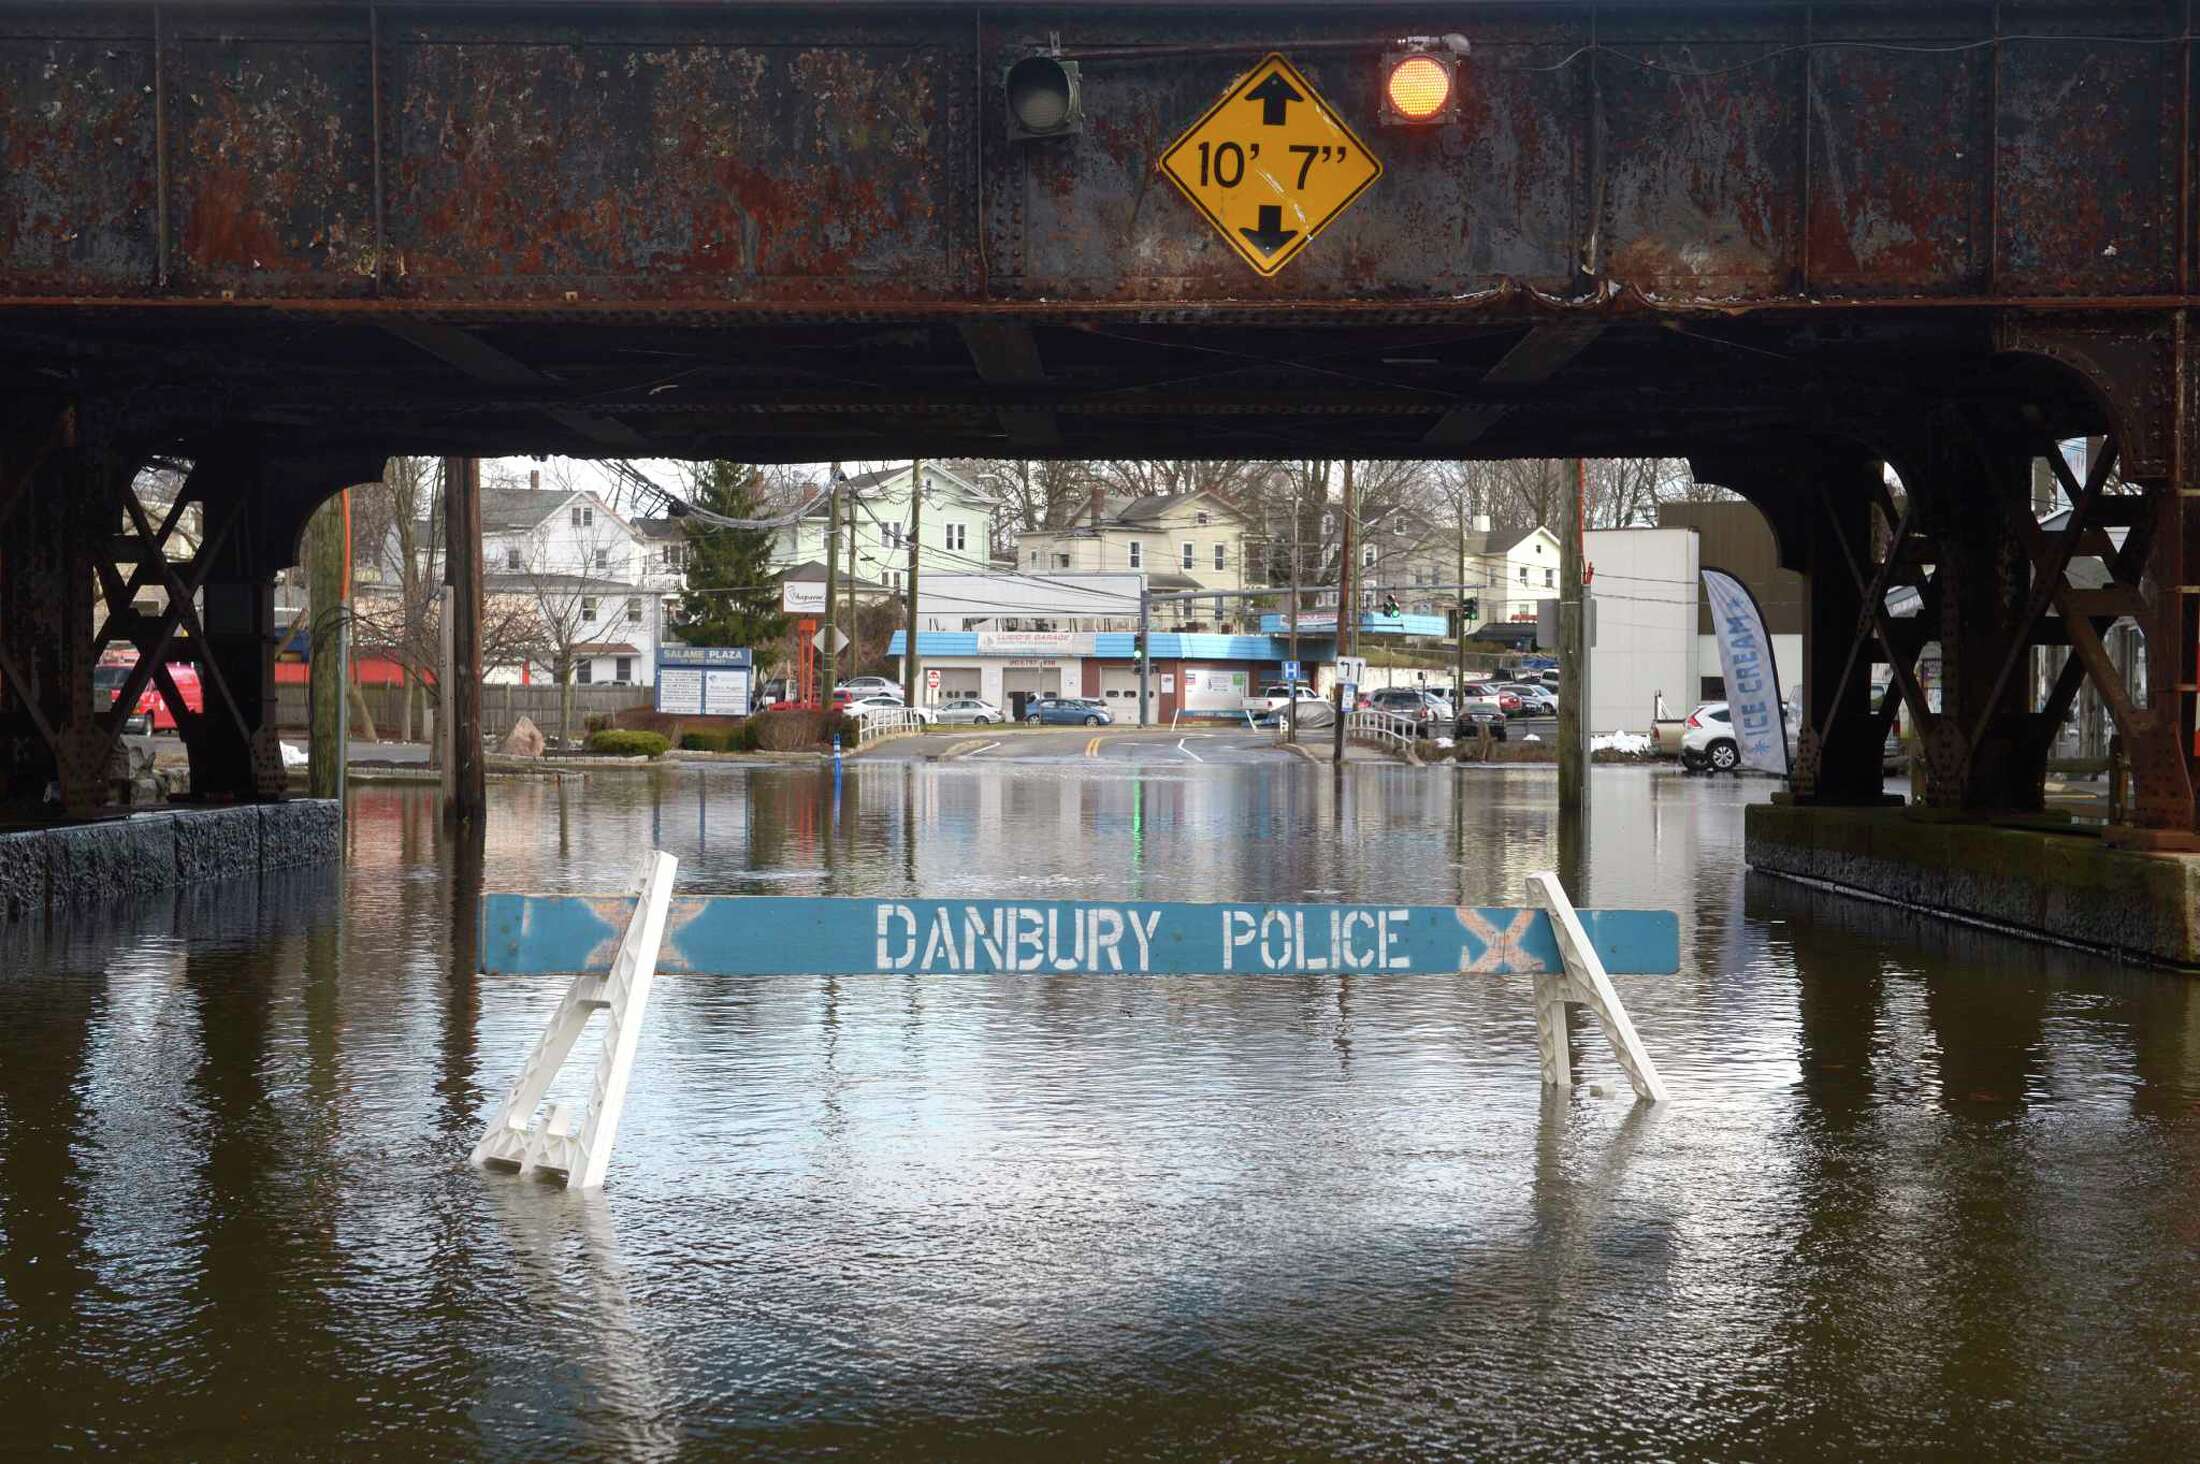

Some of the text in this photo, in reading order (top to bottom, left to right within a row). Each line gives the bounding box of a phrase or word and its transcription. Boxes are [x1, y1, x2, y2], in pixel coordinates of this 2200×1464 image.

[708, 650, 743, 660] PLAZA
[1285, 662, 1297, 679] H
[1726, 614, 1770, 737] ICE CREAM
[877, 904, 1410, 971] DANBURY POLICE
